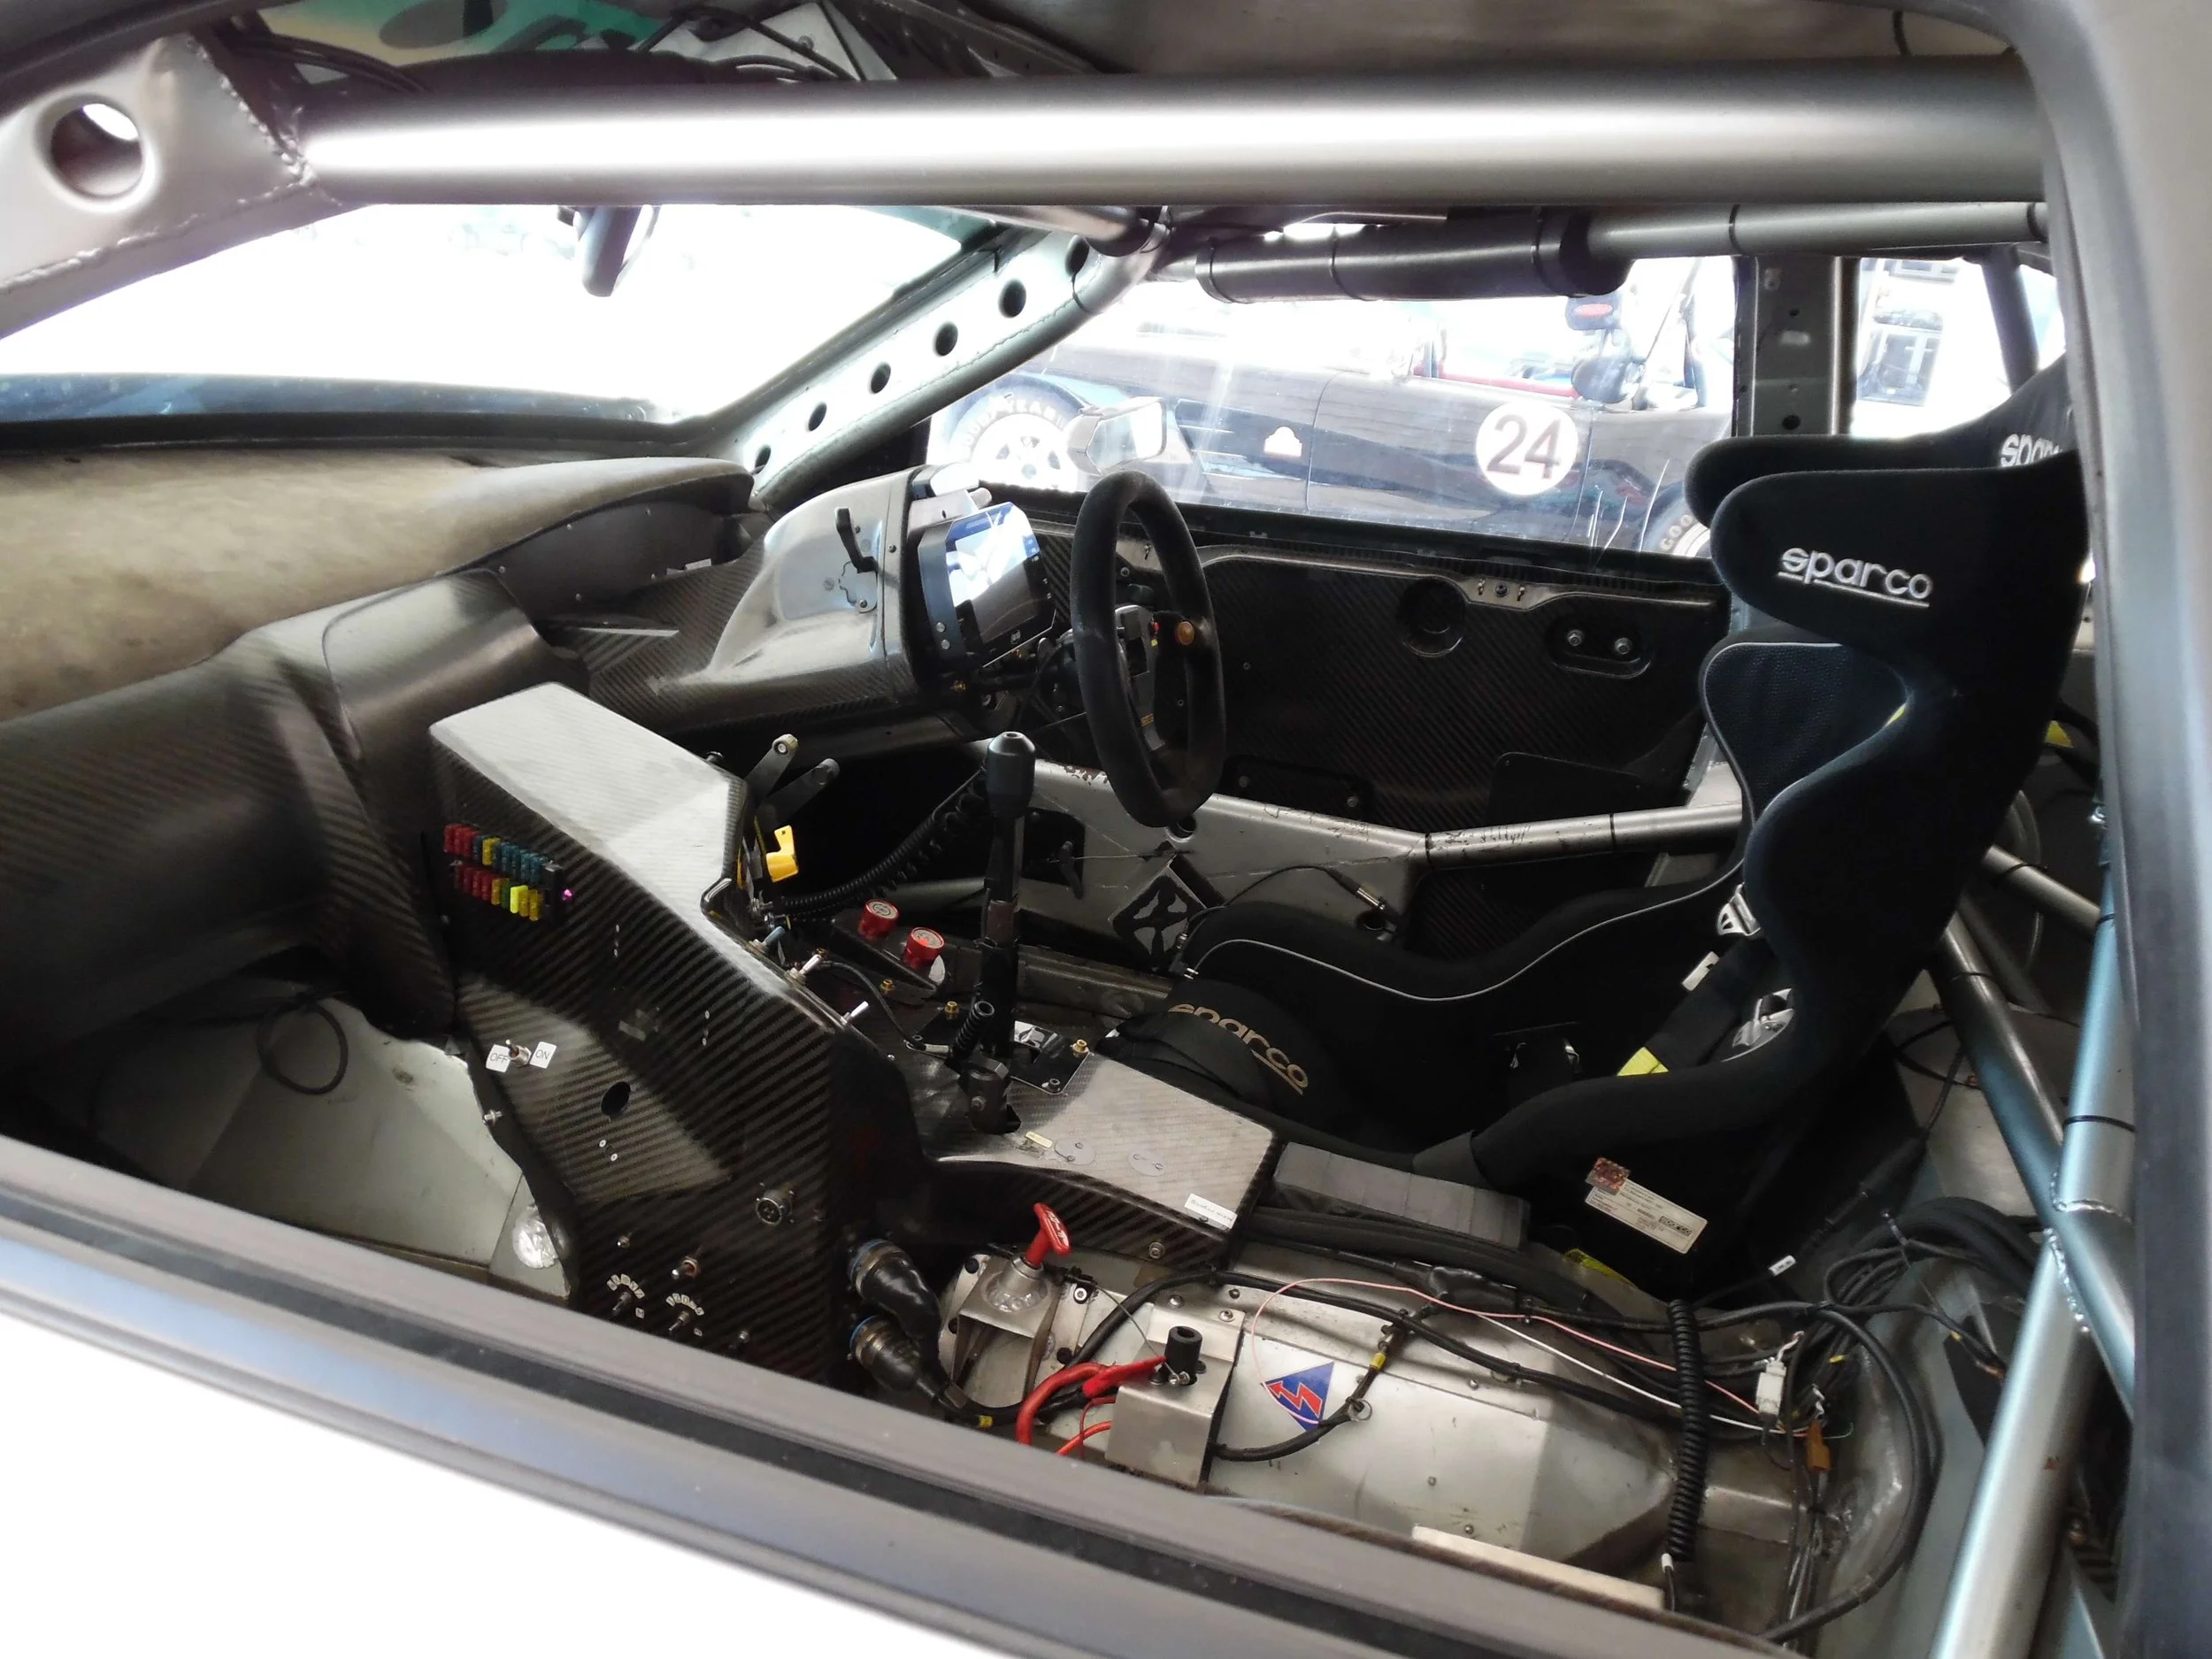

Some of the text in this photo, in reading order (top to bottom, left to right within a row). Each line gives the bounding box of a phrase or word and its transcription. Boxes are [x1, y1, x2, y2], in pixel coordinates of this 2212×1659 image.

[1486, 412, 1563, 479] 24
[1780, 546, 1933, 602] sparco
[490, 1052, 509, 1064] OFF
[535, 1048, 549, 1060] ON
